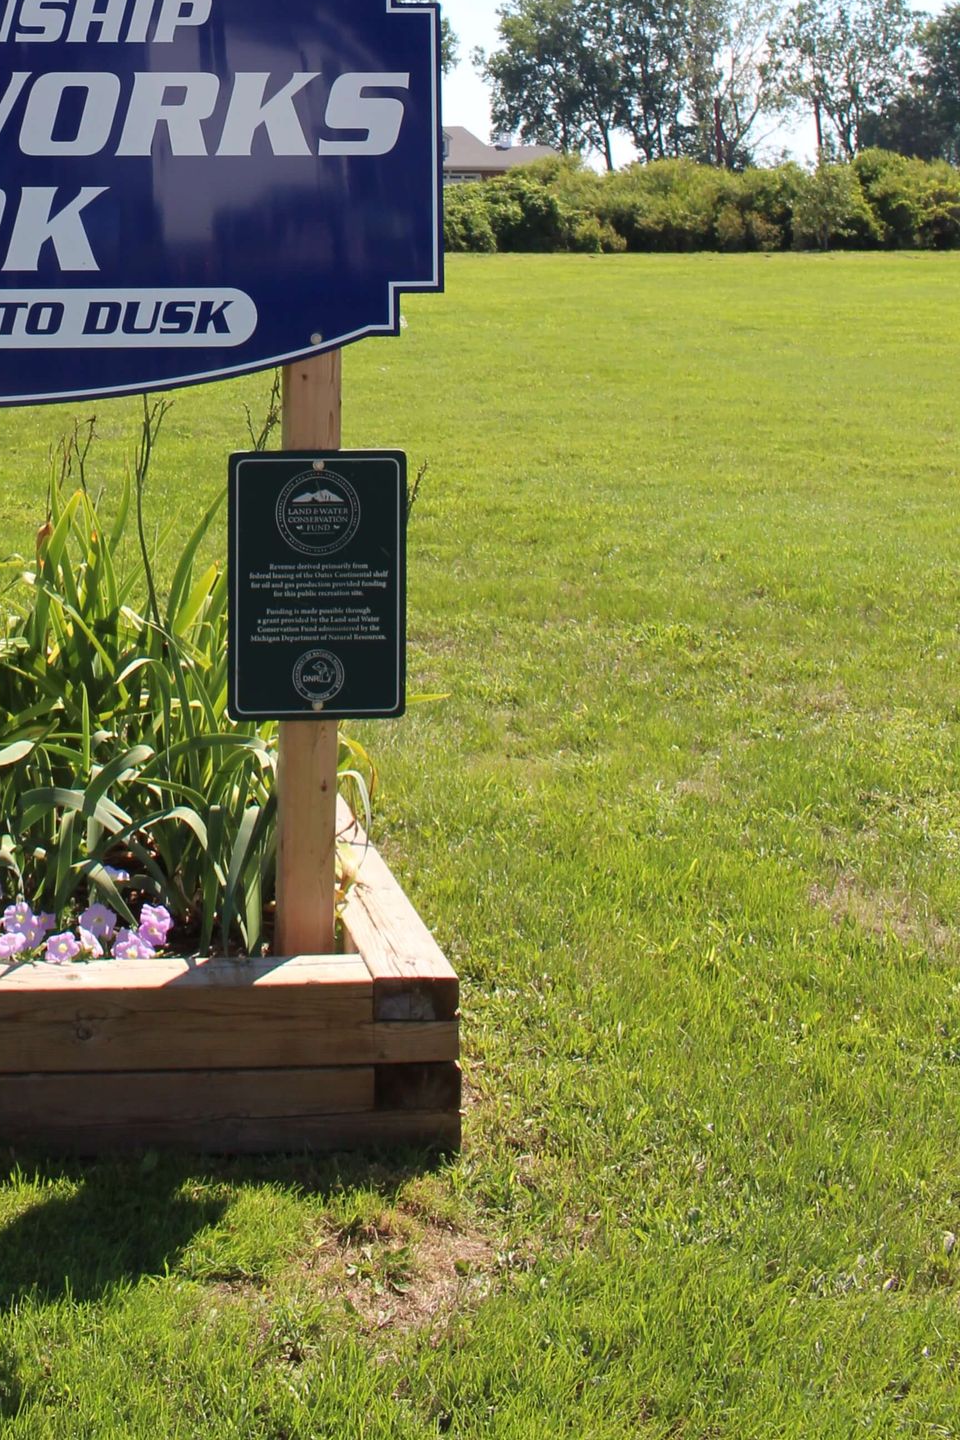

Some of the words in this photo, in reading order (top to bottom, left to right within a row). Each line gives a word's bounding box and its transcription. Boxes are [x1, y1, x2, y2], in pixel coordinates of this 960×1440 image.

[81, 300, 233, 335] DUSK
[322, 563, 351, 571] primarily
[296, 581, 331, 589] production
[332, 581, 360, 589] provided
[361, 580, 386, 588] funding
[297, 590, 316, 598] public
[266, 608, 293, 616] Funding
[345, 606, 371, 614] through
[281, 617, 309, 625] provided
[250, 635, 280, 643] Michigan
